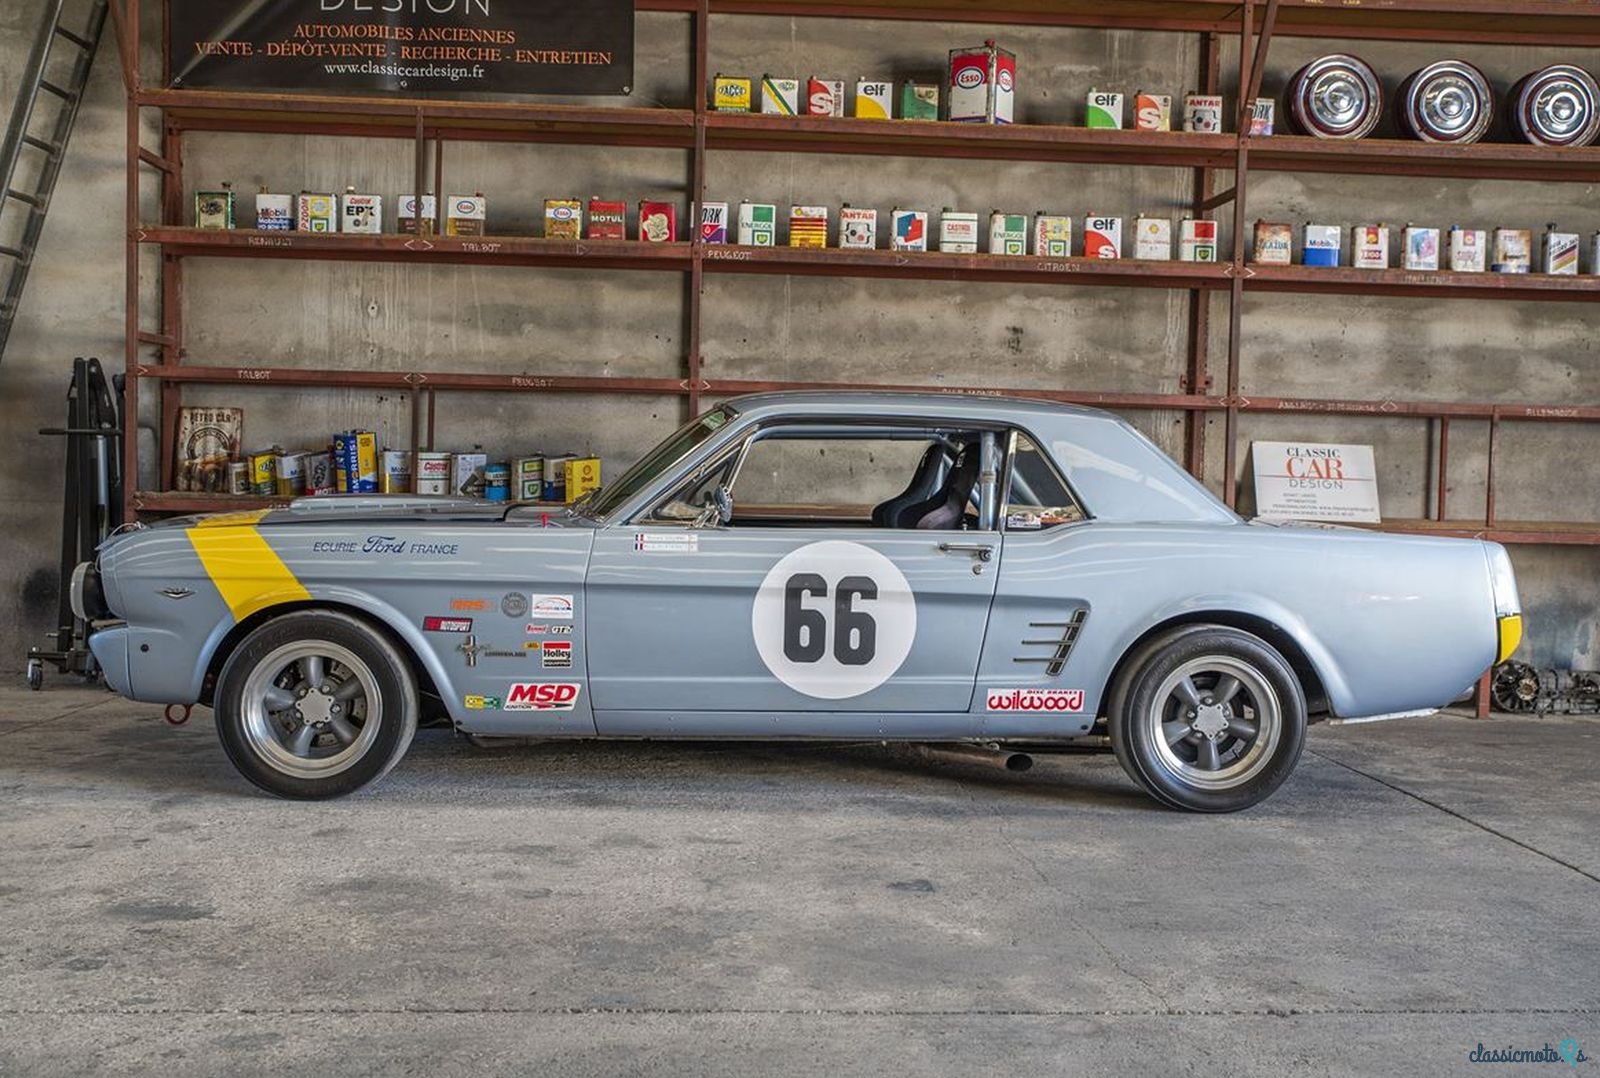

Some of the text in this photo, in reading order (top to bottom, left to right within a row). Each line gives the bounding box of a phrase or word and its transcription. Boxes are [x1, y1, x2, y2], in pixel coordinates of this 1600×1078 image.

[294, 24, 515, 44] AUTOMOBILES ANCIENNES
[195, 41, 253, 56] VENTE
[267, 40, 386, 58] DÉPÔT-VENTE
[401, 46, 502, 62] RECHERCHE
[515, 50, 611, 65] ENTRETIEN
[324, 60, 484, 81] www.classiccardesign.fr
[960, 73, 980, 84] Esso
[863, 85, 886, 97] elf
[1094, 93, 1117, 106] elf
[1189, 99, 1220, 108] ANTAR
[261, 208, 287, 217] Mobil
[702, 207, 723, 224] ORK
[842, 211, 874, 223] ANTAR
[591, 215, 623, 223] MOTUL
[1093, 219, 1116, 234] elf
[708, 250, 753, 260] PEUGEOT
[237, 371, 272, 380] TALBOT
[216, 411, 231, 423] CAR
[1287, 447, 1340, 458] CLASSIC
[1286, 457, 1343, 480] CAR
[1289, 479, 1343, 490] DESIGN
[313, 535, 459, 555] ECURIE Ford FRANCE
[783, 572, 879, 666] 66
[544, 650, 571, 659] Holley
[510, 685, 576, 702] MSD
[988, 690, 1083, 710] wilwood
